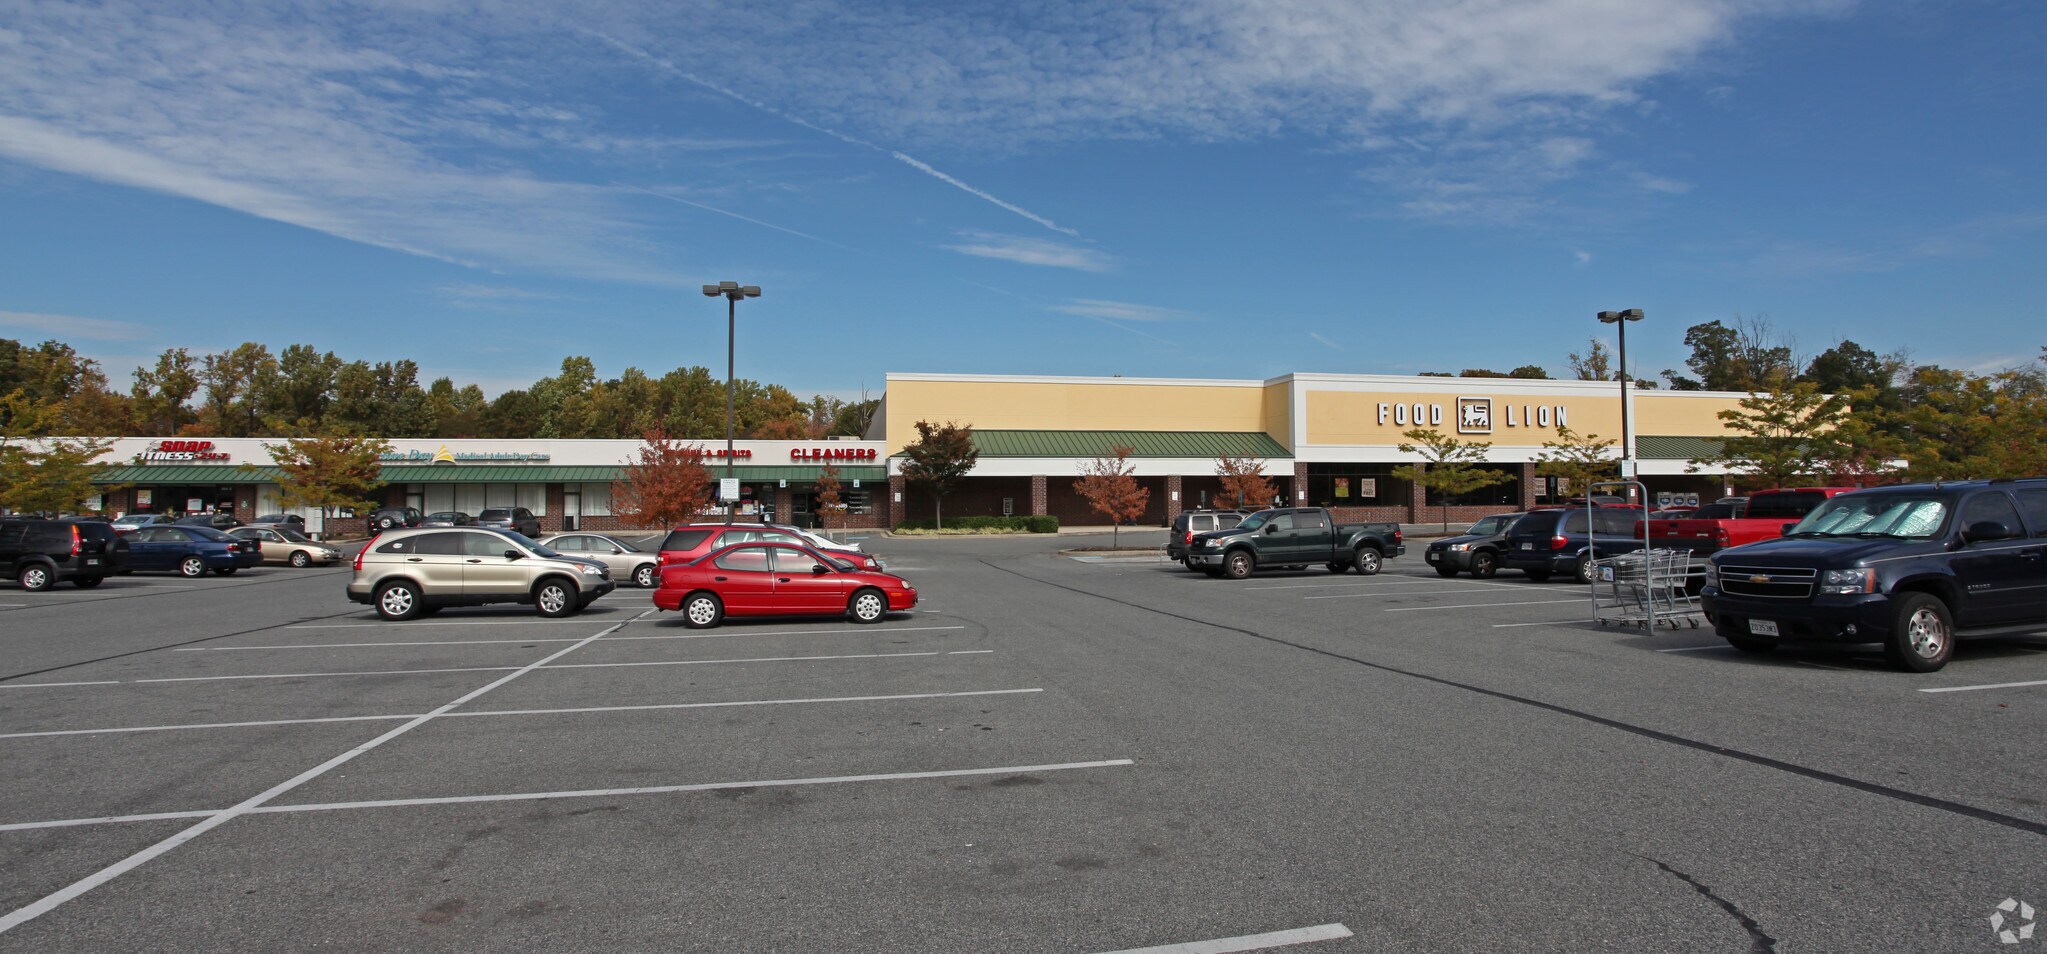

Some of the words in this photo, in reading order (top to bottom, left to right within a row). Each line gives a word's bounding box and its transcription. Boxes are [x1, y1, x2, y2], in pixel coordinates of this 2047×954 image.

[1378, 403, 1443, 426] FOOD
[1506, 405, 1567, 427] LION
[408, 449, 433, 461] Day
[456, 452, 487, 460] Medical
[706, 449, 712, 457] &
[717, 449, 752, 457] SPRITS
[790, 448, 877, 459] CLEANERS
